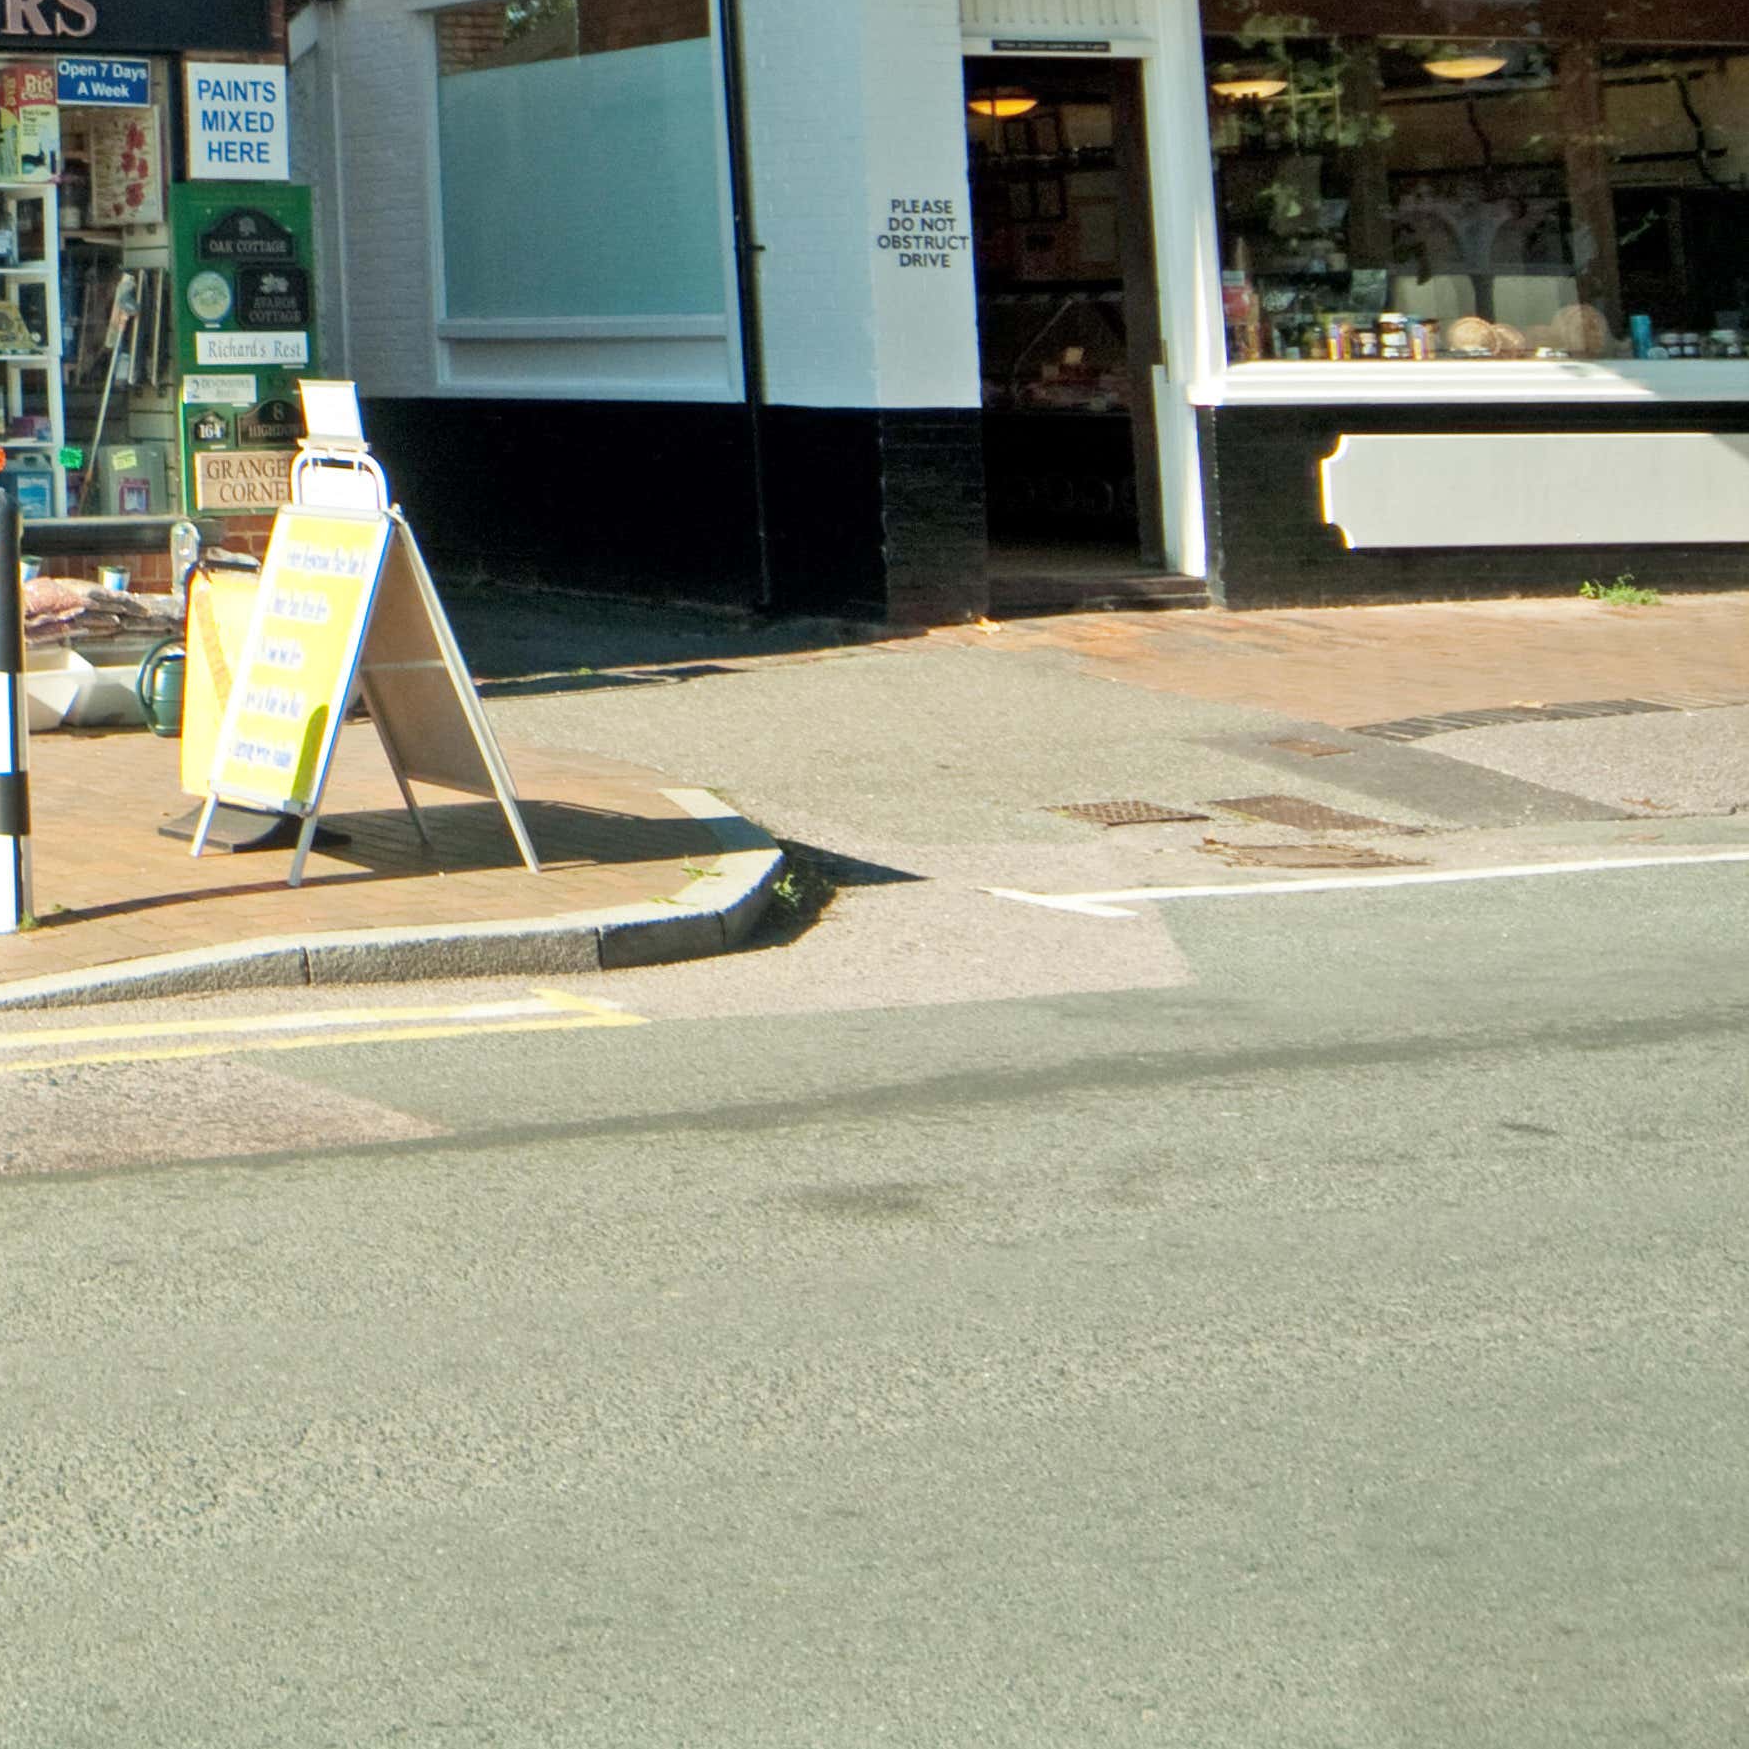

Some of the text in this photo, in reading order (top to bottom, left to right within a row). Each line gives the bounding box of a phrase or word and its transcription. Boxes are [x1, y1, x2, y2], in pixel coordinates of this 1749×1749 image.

[58, 61, 148, 81] Open 7 Days
[76, 82, 131, 98] A Week
[197, 79, 276, 103] PAINTS
[201, 110, 275, 133] MIXED
[207, 141, 270, 163] HERE
[890, 199, 953, 213] PLEASE
[888, 217, 956, 231] DO NOT
[236, 240, 287, 253] COTTAGE
[877, 234, 969, 250] OBSTRUCT
[899, 253, 951, 268] DRIVE
[207, 338, 302, 358] Richard's Rest
[272, 403, 286, 422] 8
[206, 458, 291, 480] GRANGE
